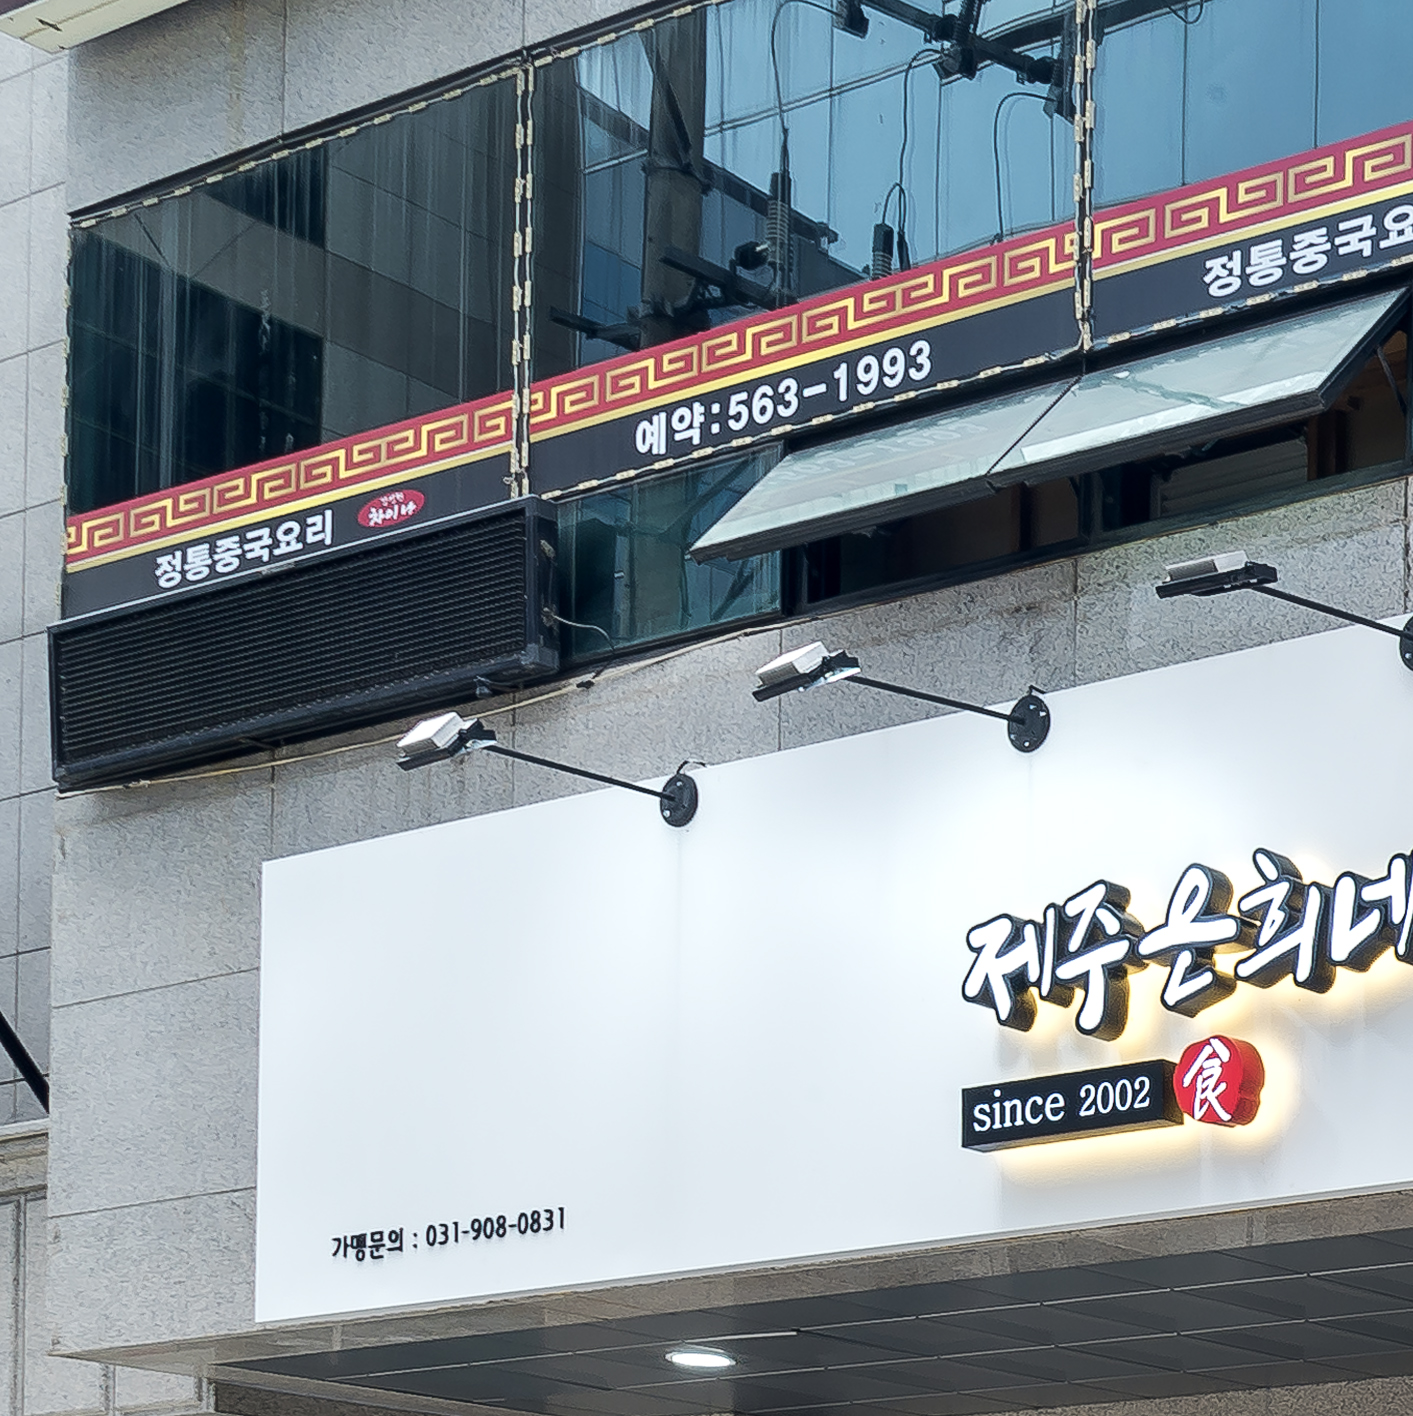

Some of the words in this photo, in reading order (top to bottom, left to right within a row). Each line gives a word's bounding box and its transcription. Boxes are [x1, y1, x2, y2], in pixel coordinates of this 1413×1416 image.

[635, 339, 933, 456] 예약:563-1993
[154, 511, 334, 590] 정통중국요리
[972, 1088, 1065, 1133] since
[1079, 1076, 1151, 1117] 2002
[1182, 1037, 1232, 1122] 食
[331, 1227, 404, 1262] 가맹문의
[425, 1206, 565, 1247] 031-908-0831
